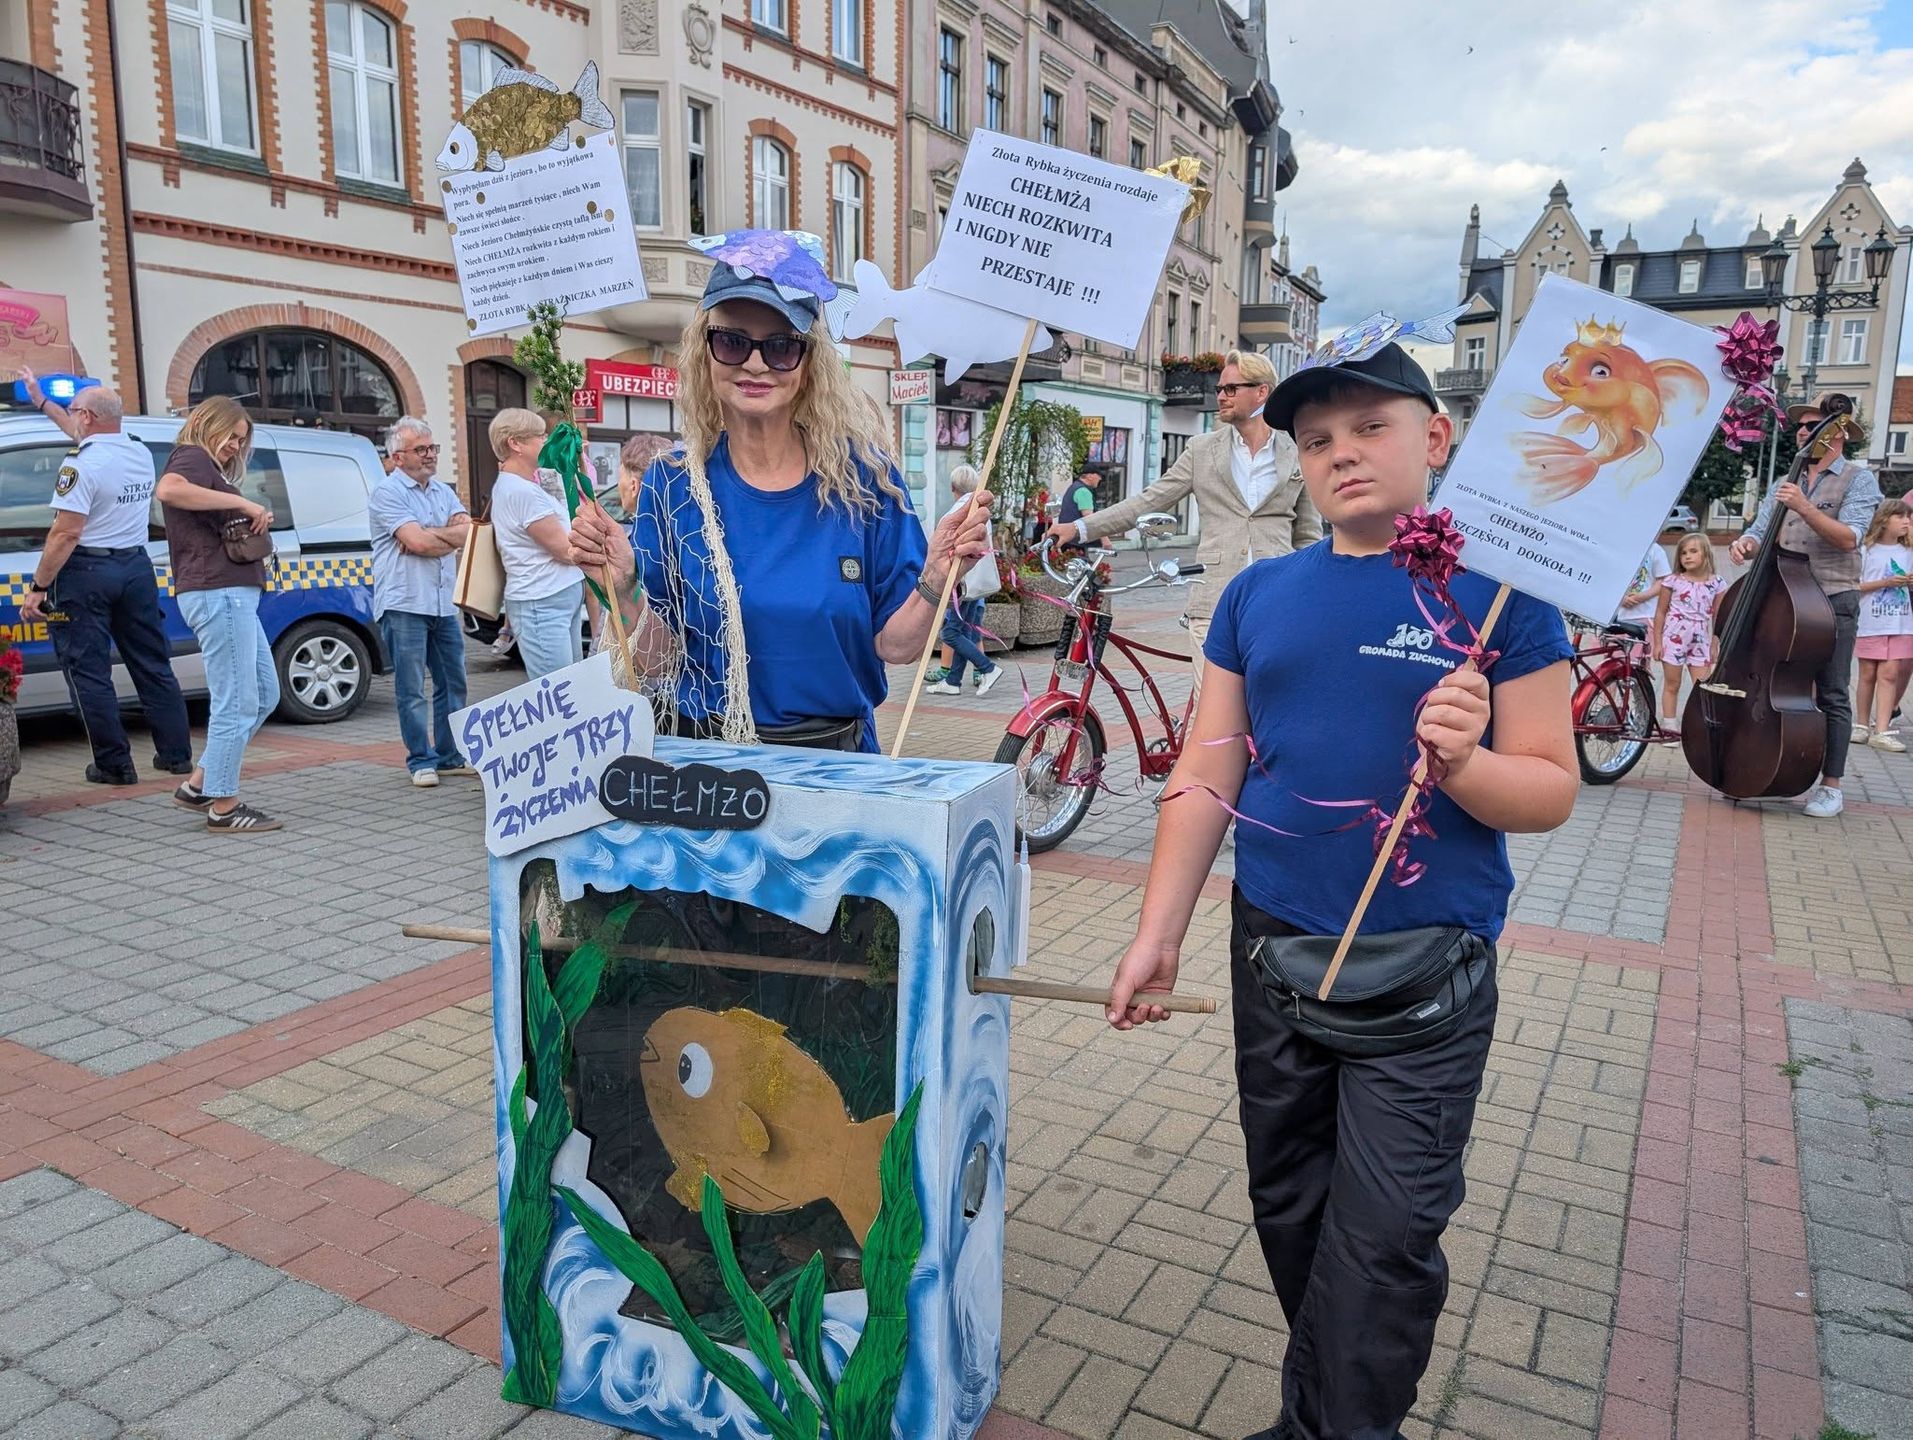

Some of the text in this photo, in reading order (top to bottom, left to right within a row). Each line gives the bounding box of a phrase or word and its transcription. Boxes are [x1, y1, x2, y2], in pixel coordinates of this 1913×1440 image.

[451, 180, 490, 196] Wypłynęłam
[491, 174, 505, 185] dziś
[509, 168, 534, 182] jeziora
[538, 164, 548, 172] bo
[548, 162, 556, 170] to
[556, 151, 594, 168] wyjątkowa
[992, 147, 1158, 203] Złota Rybka życzenia rozdaje
[453, 199, 471, 211] pora.
[456, 213, 475, 225] Niech
[475, 210, 485, 220] się
[484, 204, 507, 218] spełnią
[508, 197, 534, 210] marzeń
[534, 191, 558, 206] tysiące
[562, 185, 581, 196] niech
[581, 181, 601, 191] Wam
[1010, 176, 1092, 213] CHEŁMŻA
[459, 226, 481, 237] zawsze
[500, 214, 521, 225] słońce
[461, 240, 480, 252] Niech
[480, 237, 504, 247] Jezioro
[503, 224, 553, 242] Chełmżyńskie
[551, 218, 574, 230] czystą
[573, 214, 590, 225] taflą
[954, 217, 1053, 258] I NIGDY NIE
[963, 191, 1113, 248] NIECH ROZKWITA
[464, 256, 482, 267] Niech
[482, 246, 521, 263] CHEŁMŻA
[522, 241, 553, 254] rozkwita
[559, 232, 586, 244] każdym
[586, 226, 611, 237] rokiem
[611, 223, 616, 233] i
[467, 267, 497, 280] zachwyca
[497, 263, 516, 272] swym
[516, 256, 546, 268] urokiem
[470, 284, 488, 295] Niech
[488, 277, 517, 292] pięknieje
[523, 270, 550, 282] każdym
[551, 266, 574, 276] dniem
[574, 262, 578, 271] i
[577, 261, 593, 270] Was
[594, 256, 614, 266] cieszy
[980, 256, 1101, 304] PRZESTAJE !!!
[472, 291, 511, 307] każdy dzień.
[479, 278, 635, 322] ZŁOTA RYBKA STRAŻNICZKA MARZEŃ
[891, 382, 928, 401] Maciek
[894, 372, 928, 382] SKLEP
[1455, 482, 1478, 496] ZŁOTA
[1479, 492, 1501, 506] RYBKA
[1509, 504, 1540, 521] NASZEGO
[1540, 517, 1568, 533] JEZIORA
[1569, 528, 1590, 542] WOŁA
[1452, 519, 1592, 584] SZCZĘŚCIA DOOKOŁA !!!
[1358, 645, 1456, 669] GROMADA ZUCHOWA
[482, 704, 634, 789] TWOJE TRZY
